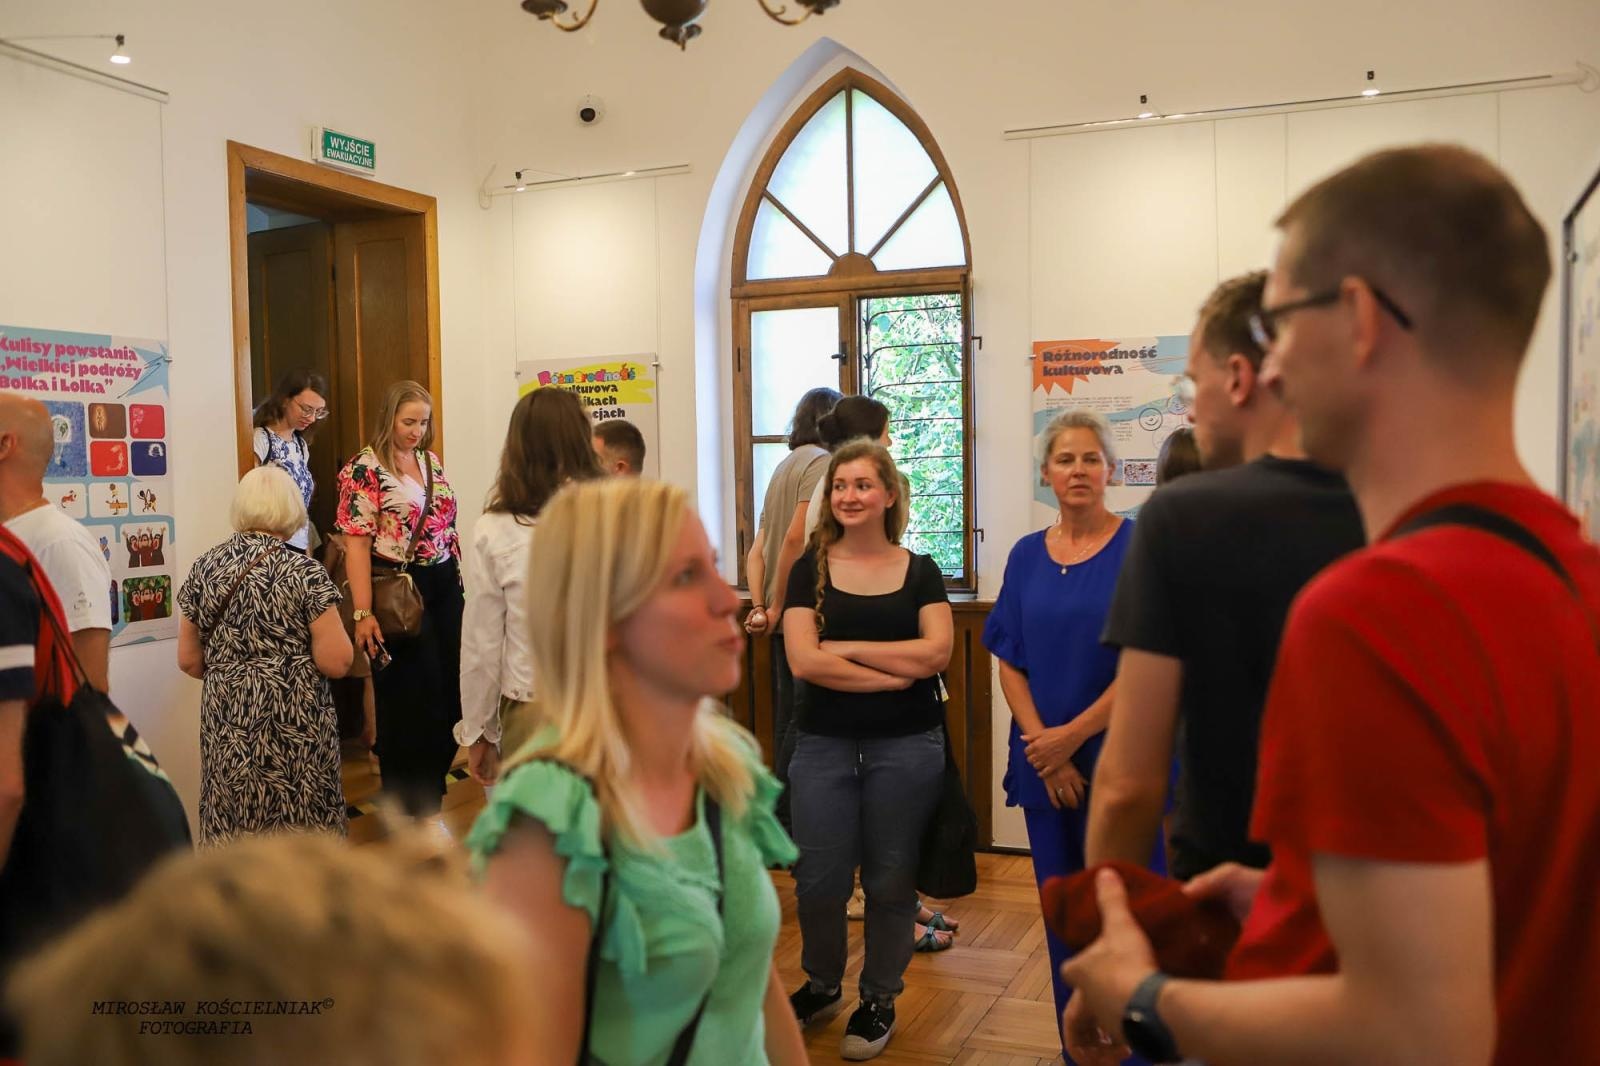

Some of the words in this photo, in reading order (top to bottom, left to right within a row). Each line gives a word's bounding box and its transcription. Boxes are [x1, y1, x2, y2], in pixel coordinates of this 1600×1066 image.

[330, 136, 370, 157] WYJŚCIE
[326, 148, 373, 168] EWAKUACYJNE
[54, 344, 138, 361] powstania
[1043, 345, 1158, 363] Różnorodność
[78, 362, 142, 381] podróży
[537, 363, 636, 386] Różnorodność
[1043, 364, 1124, 377] kulturowa
[0, 374, 49, 391] Bolka
[52, 376, 58, 391] i
